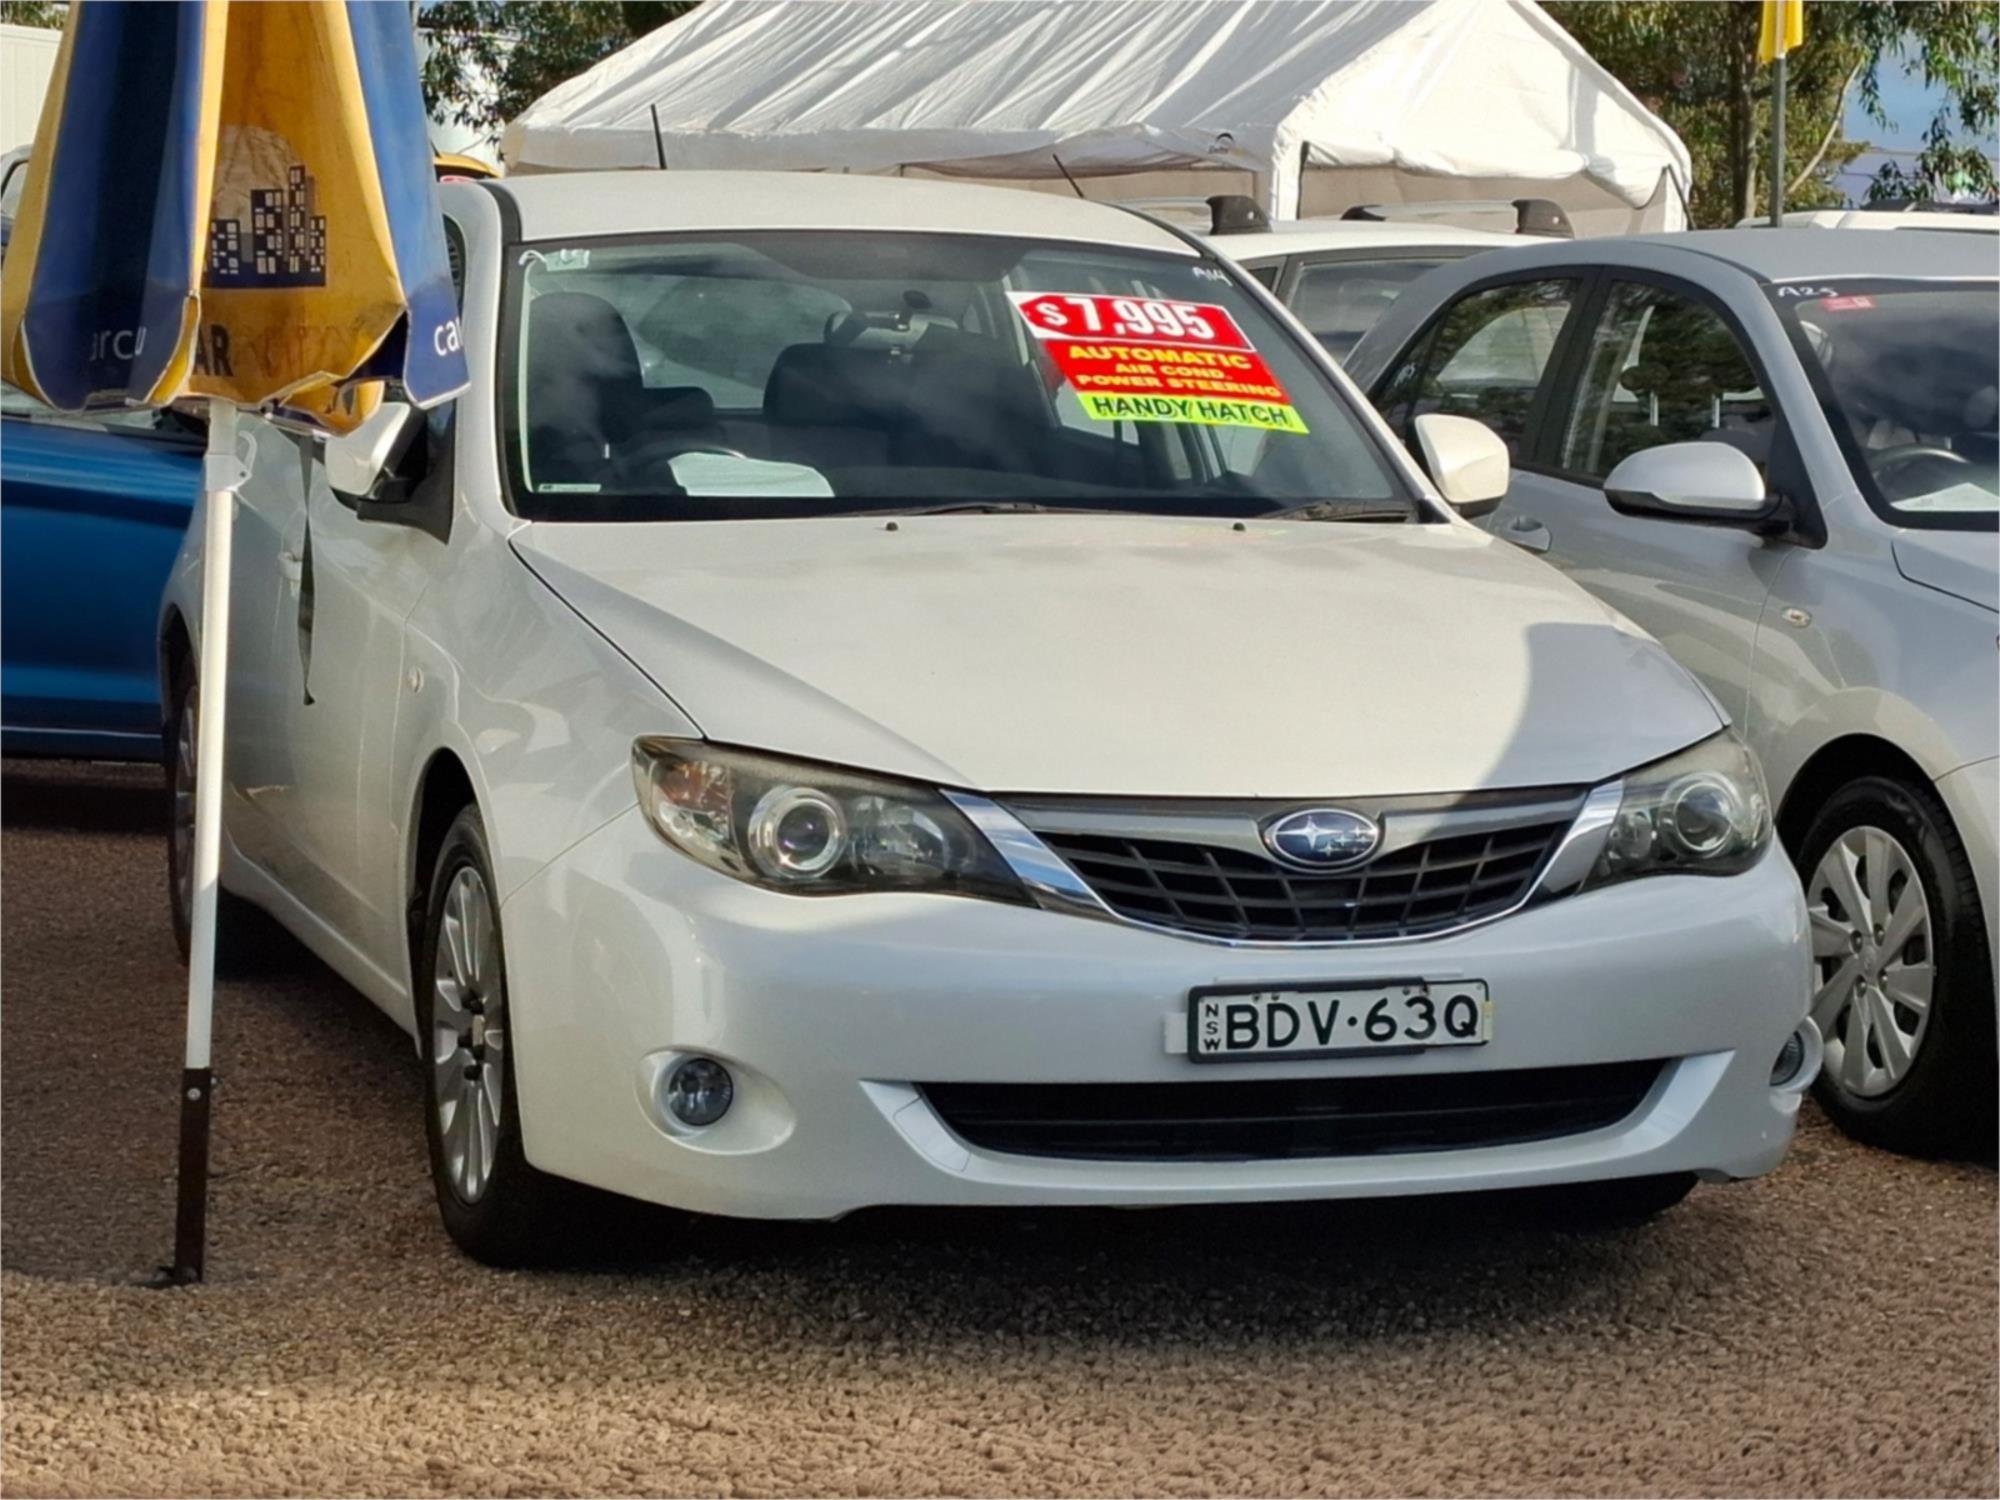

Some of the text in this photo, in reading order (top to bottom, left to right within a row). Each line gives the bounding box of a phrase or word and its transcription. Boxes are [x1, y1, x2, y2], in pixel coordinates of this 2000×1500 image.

[1036, 297, 1216, 339] $7,995
[1069, 345, 1252, 369] AUTOMATIC
[1115, 363, 1157, 376] AIR
[1076, 374, 1283, 398] POWER STEERING
[1091, 396, 1290, 424] HANDY HATCH
[1204, 1003, 1222, 1051] NSW
